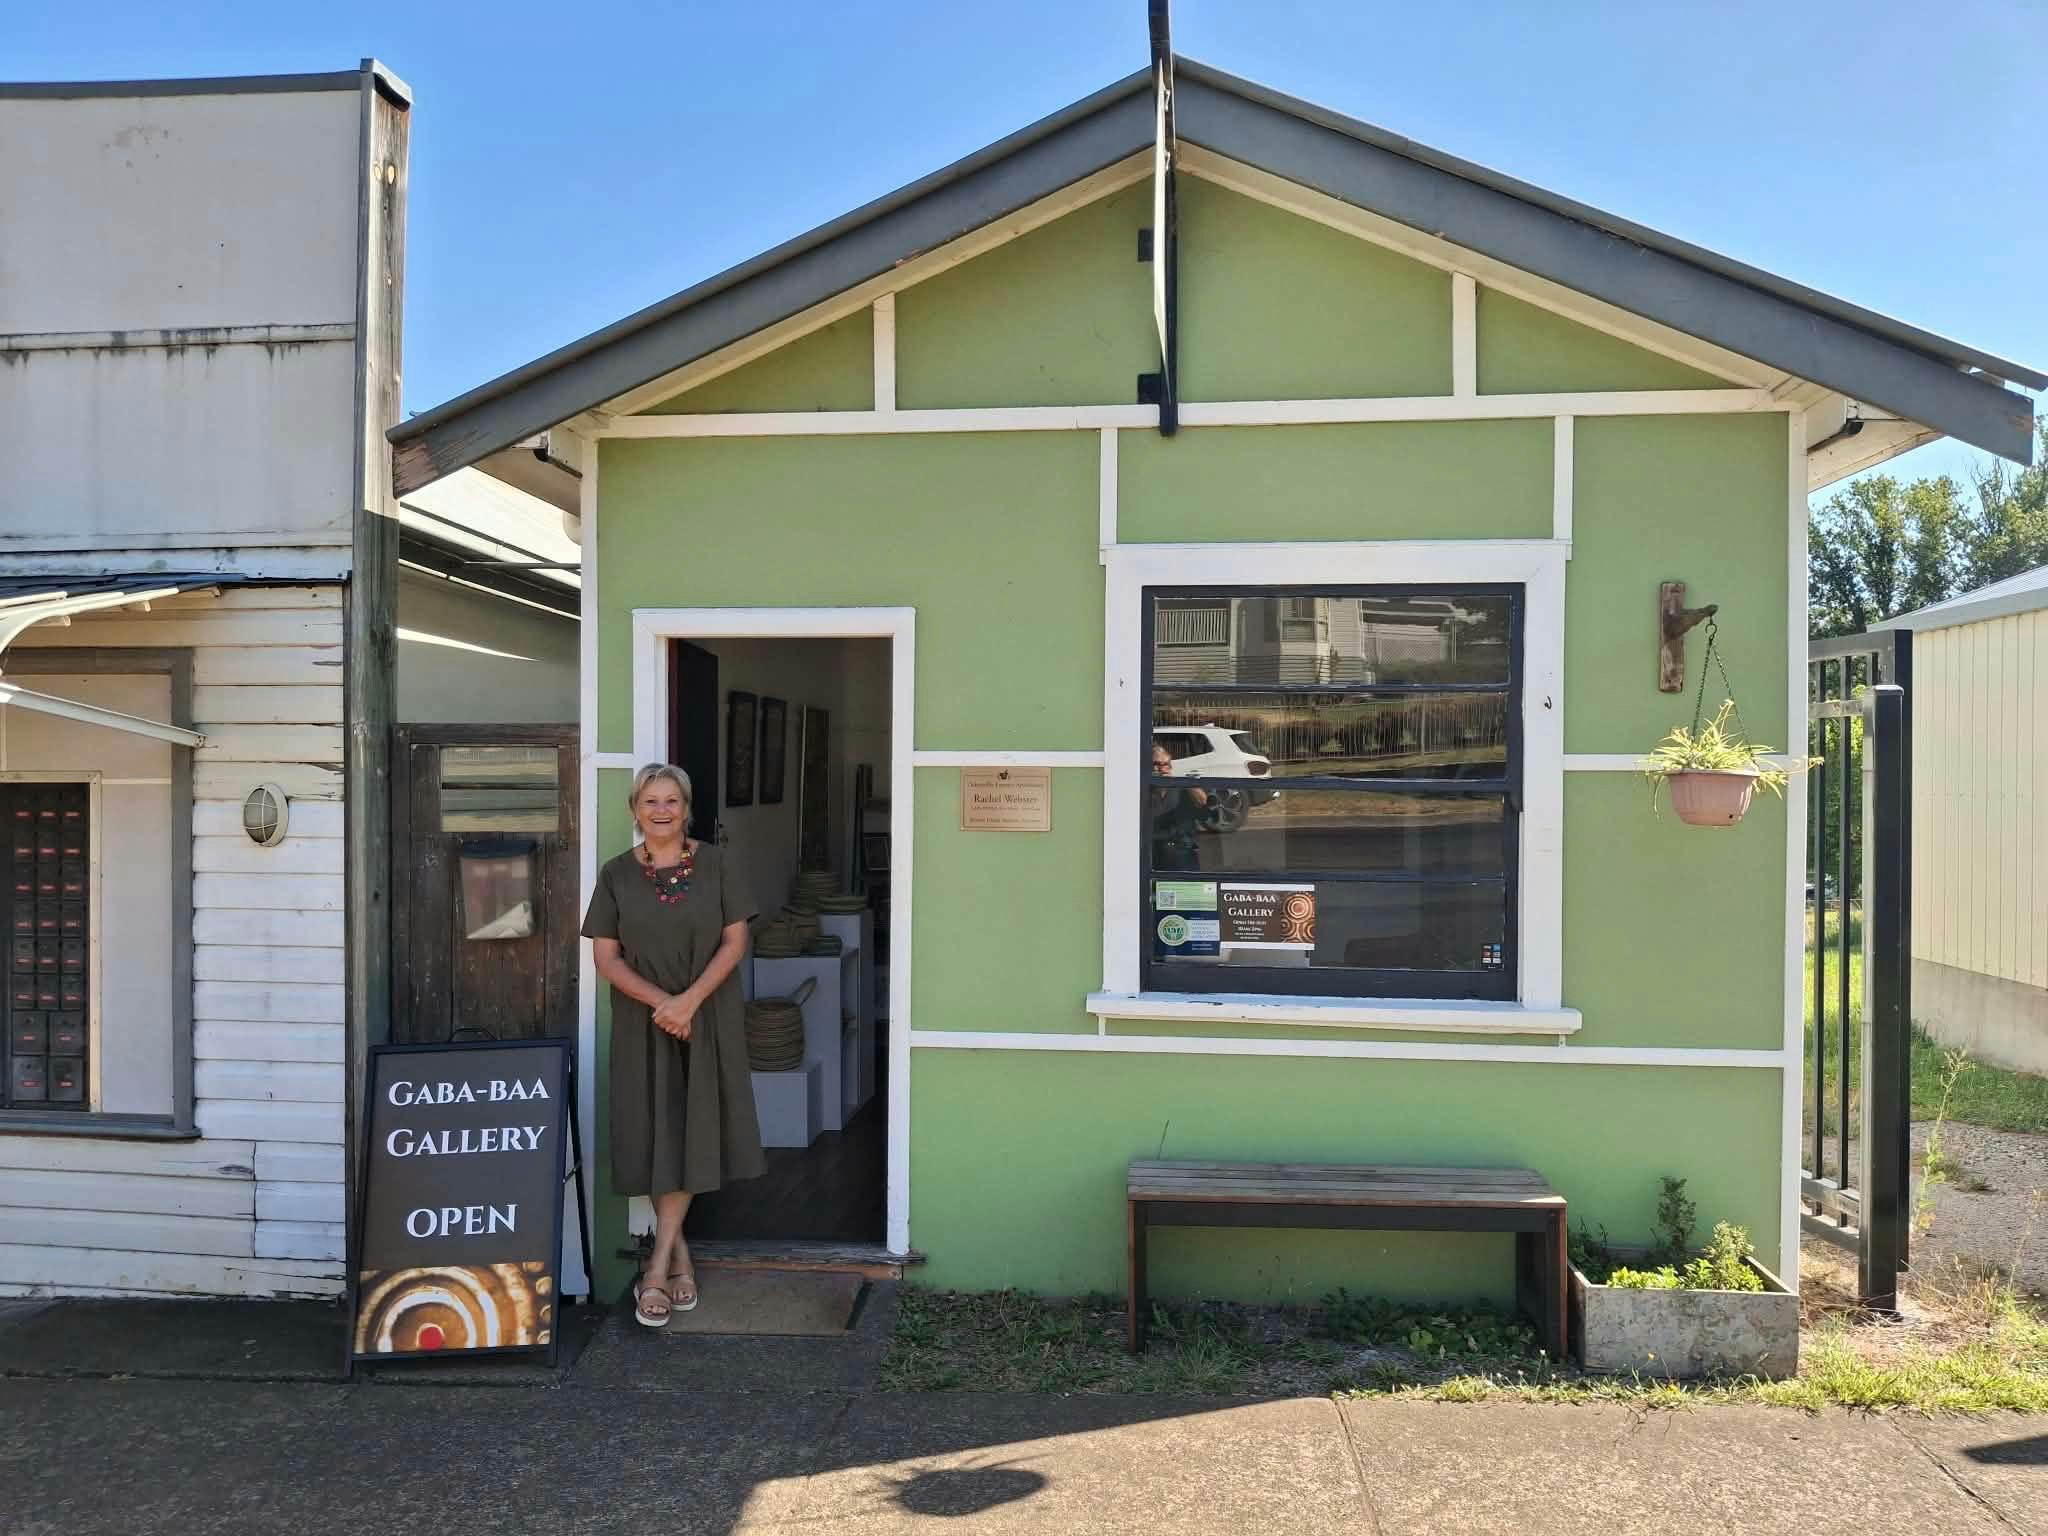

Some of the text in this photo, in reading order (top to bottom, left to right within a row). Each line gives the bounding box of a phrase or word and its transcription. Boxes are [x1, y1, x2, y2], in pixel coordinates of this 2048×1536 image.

[1223, 892, 1276, 903] GABA-BAA
[1227, 907, 1274, 917] GALLERY
[388, 1077, 550, 1106] GABA-BAA
[386, 1125, 548, 1157] GALLERY
[406, 1203, 518, 1239] OPEN
